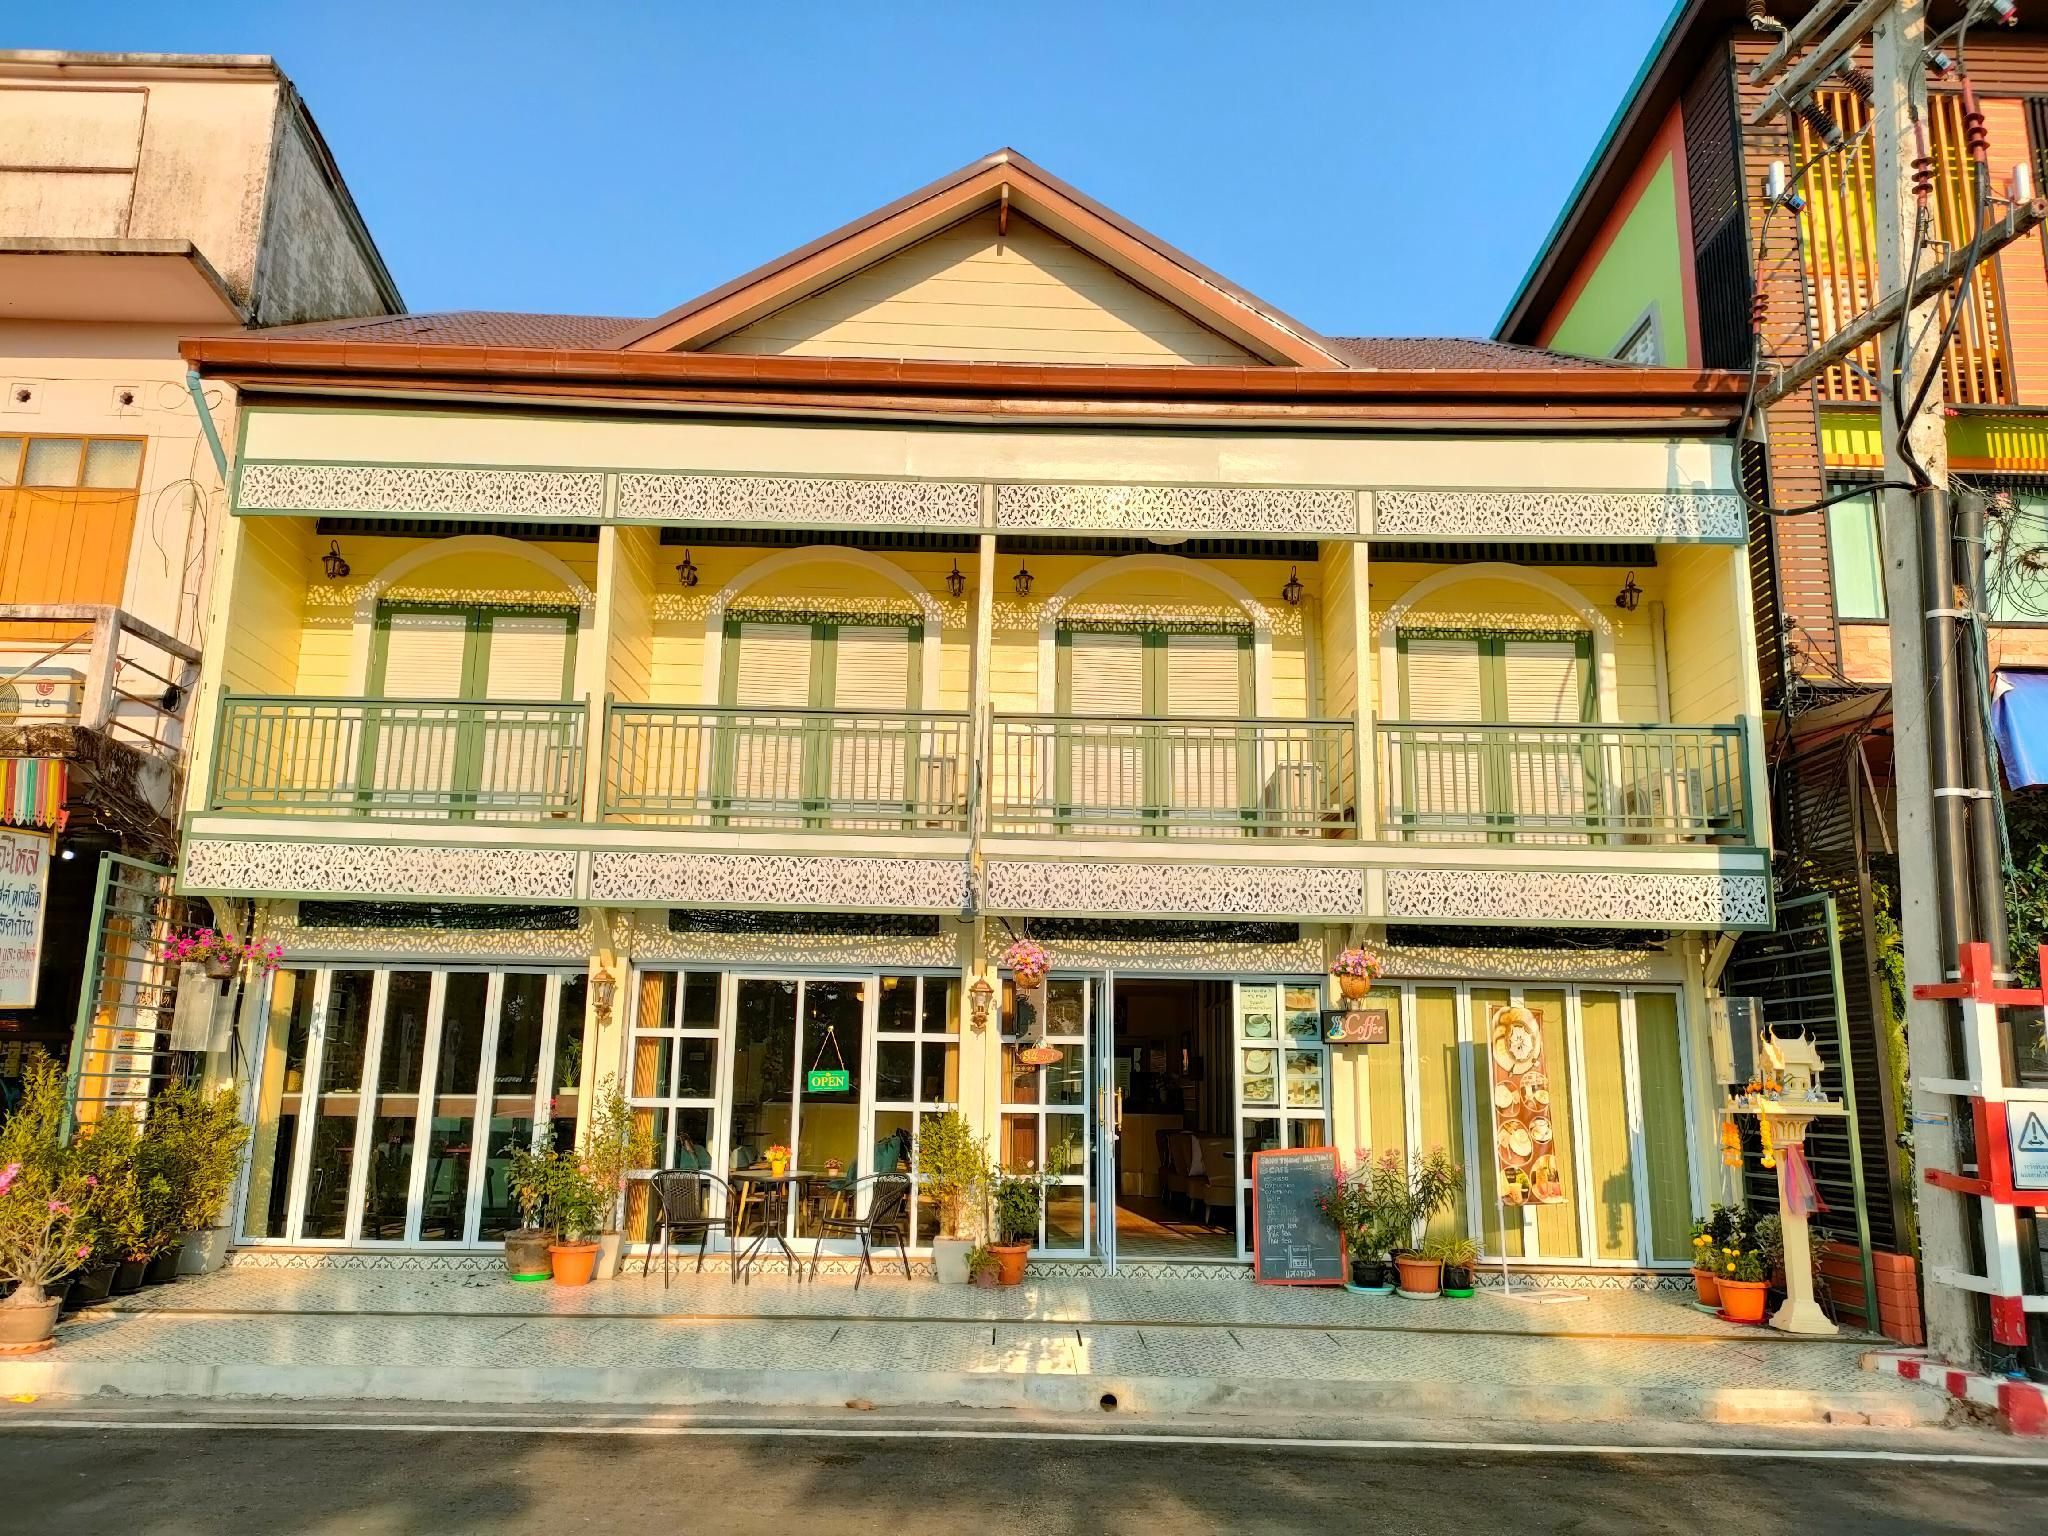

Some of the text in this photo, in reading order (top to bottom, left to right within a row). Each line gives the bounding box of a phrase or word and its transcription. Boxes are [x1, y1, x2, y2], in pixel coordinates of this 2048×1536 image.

[35, 699, 51, 708] LG
[1345, 1013, 1384, 1041] Coffee
[811, 1075, 845, 1088] OPEN
